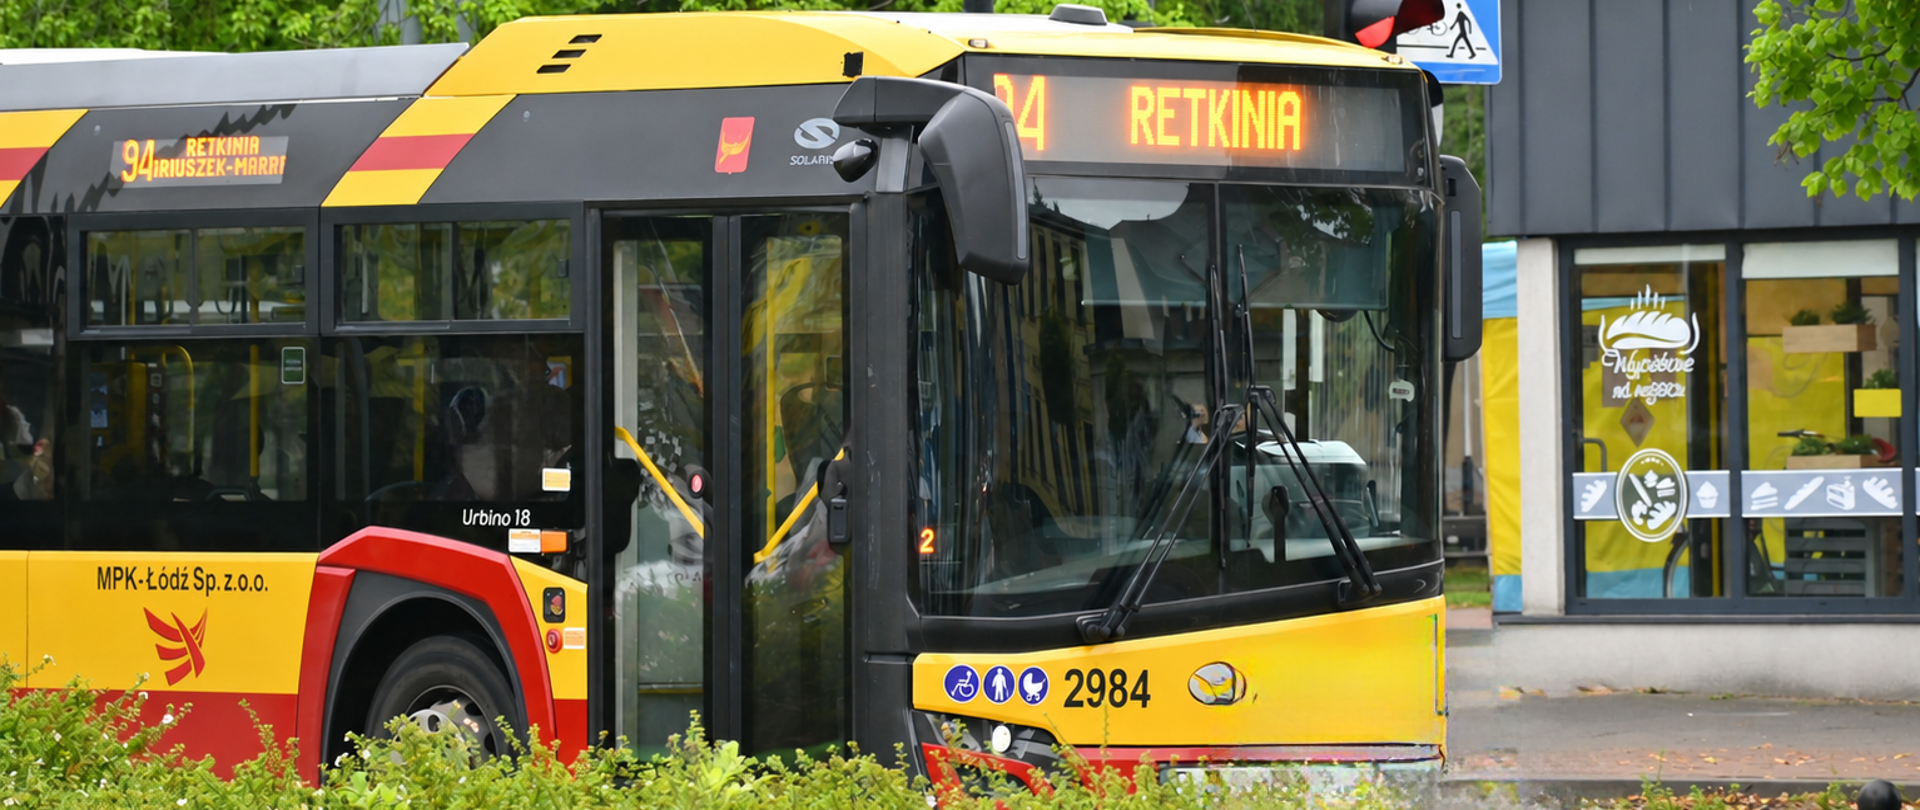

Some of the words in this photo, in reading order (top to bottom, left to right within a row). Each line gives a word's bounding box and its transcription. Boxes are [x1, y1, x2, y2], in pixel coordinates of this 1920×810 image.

[1131, 85, 1302, 151] RETKINIA
[121, 138, 155, 183] 94
[186, 136, 260, 157] RETKINIA
[462, 508, 511, 527] Urbino
[514, 508, 531, 527] 18
[919, 528, 935, 554] 2
[97, 566, 190, 591] MPK-Łódź
[192, 566, 221, 598] Sp.
[223, 573, 269, 592] z.o.o.
[1063, 667, 1152, 709] 2984
